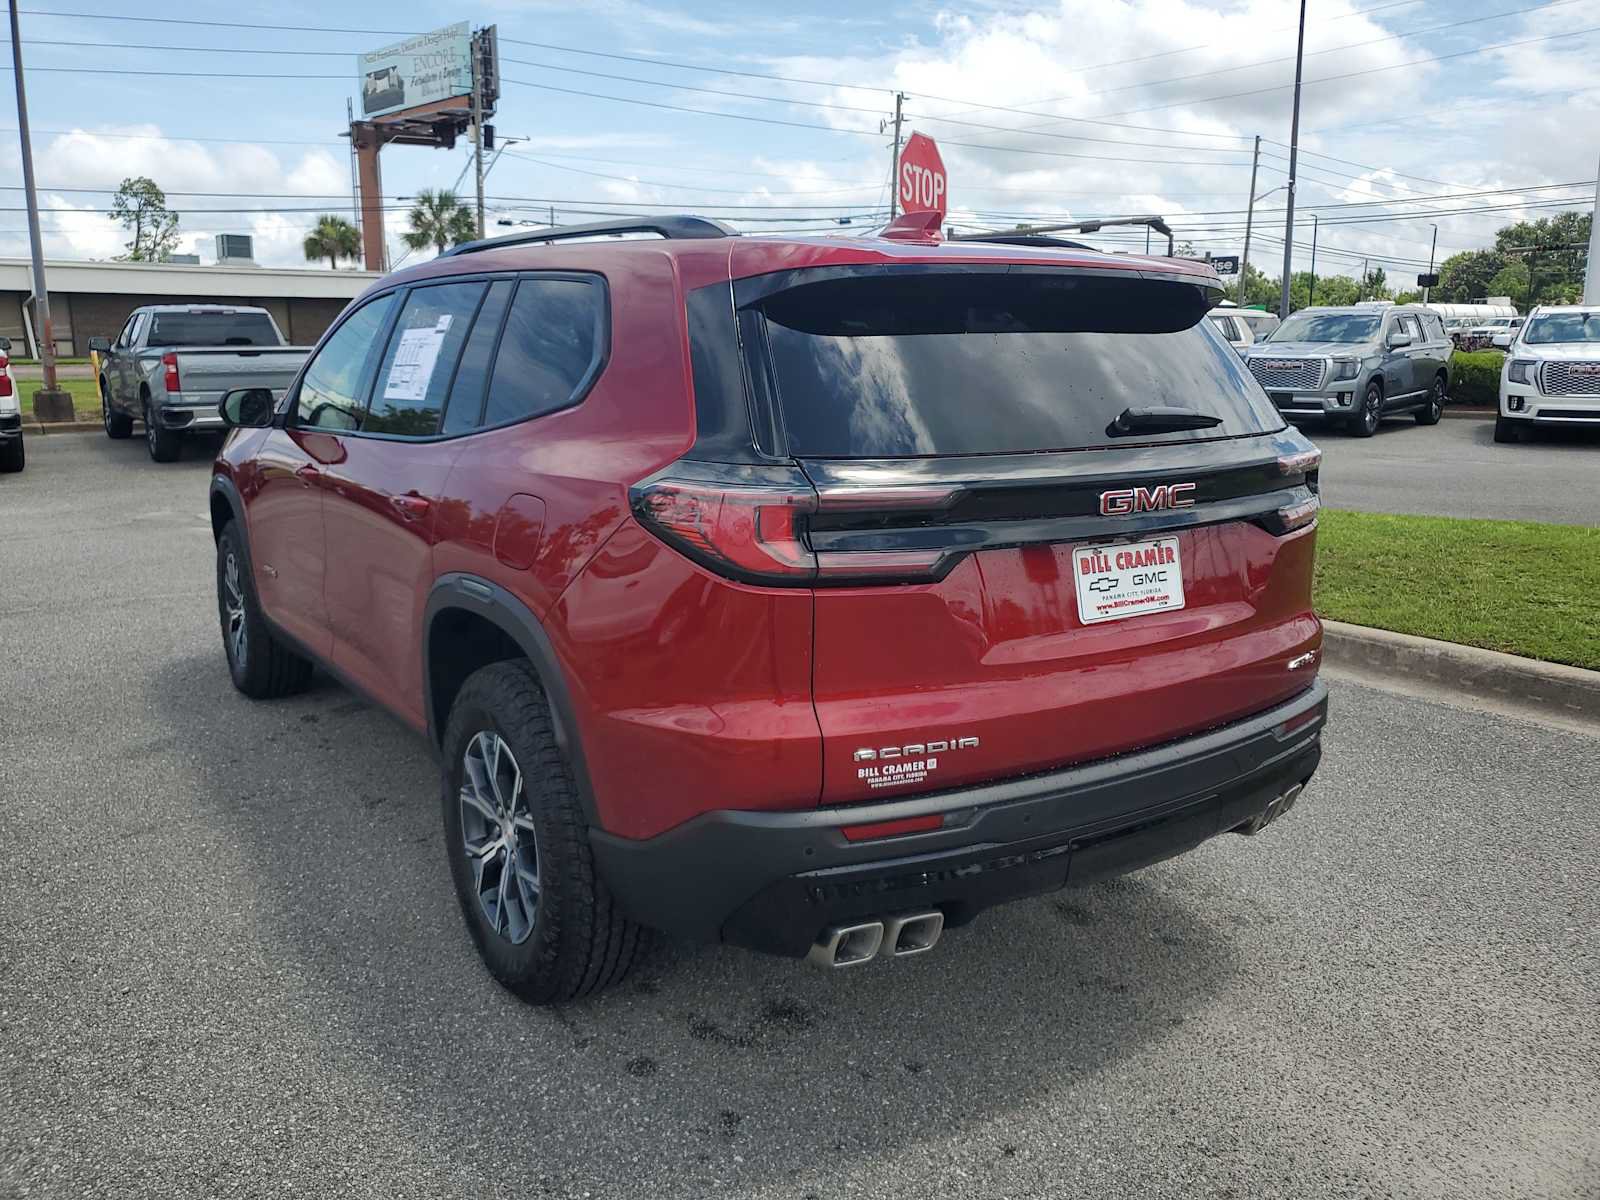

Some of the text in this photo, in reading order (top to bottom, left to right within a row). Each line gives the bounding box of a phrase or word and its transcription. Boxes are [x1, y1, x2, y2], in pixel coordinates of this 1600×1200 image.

[902, 161, 944, 209] STOP
[1100, 482, 1196, 516] GMC
[1080, 546, 1176, 575] BILL CRAMER
[1132, 571, 1168, 586] GMC
[1102, 592, 1125, 601] PANAMA
[1141, 587, 1162, 596] FLORIDA
[853, 736, 980, 762] ACADIA
[858, 767, 879, 778] BILL
[882, 761, 925, 776] CRAMER
[867, 775, 892, 784] PANAMA
[906, 770, 928, 779] FLORIDA
